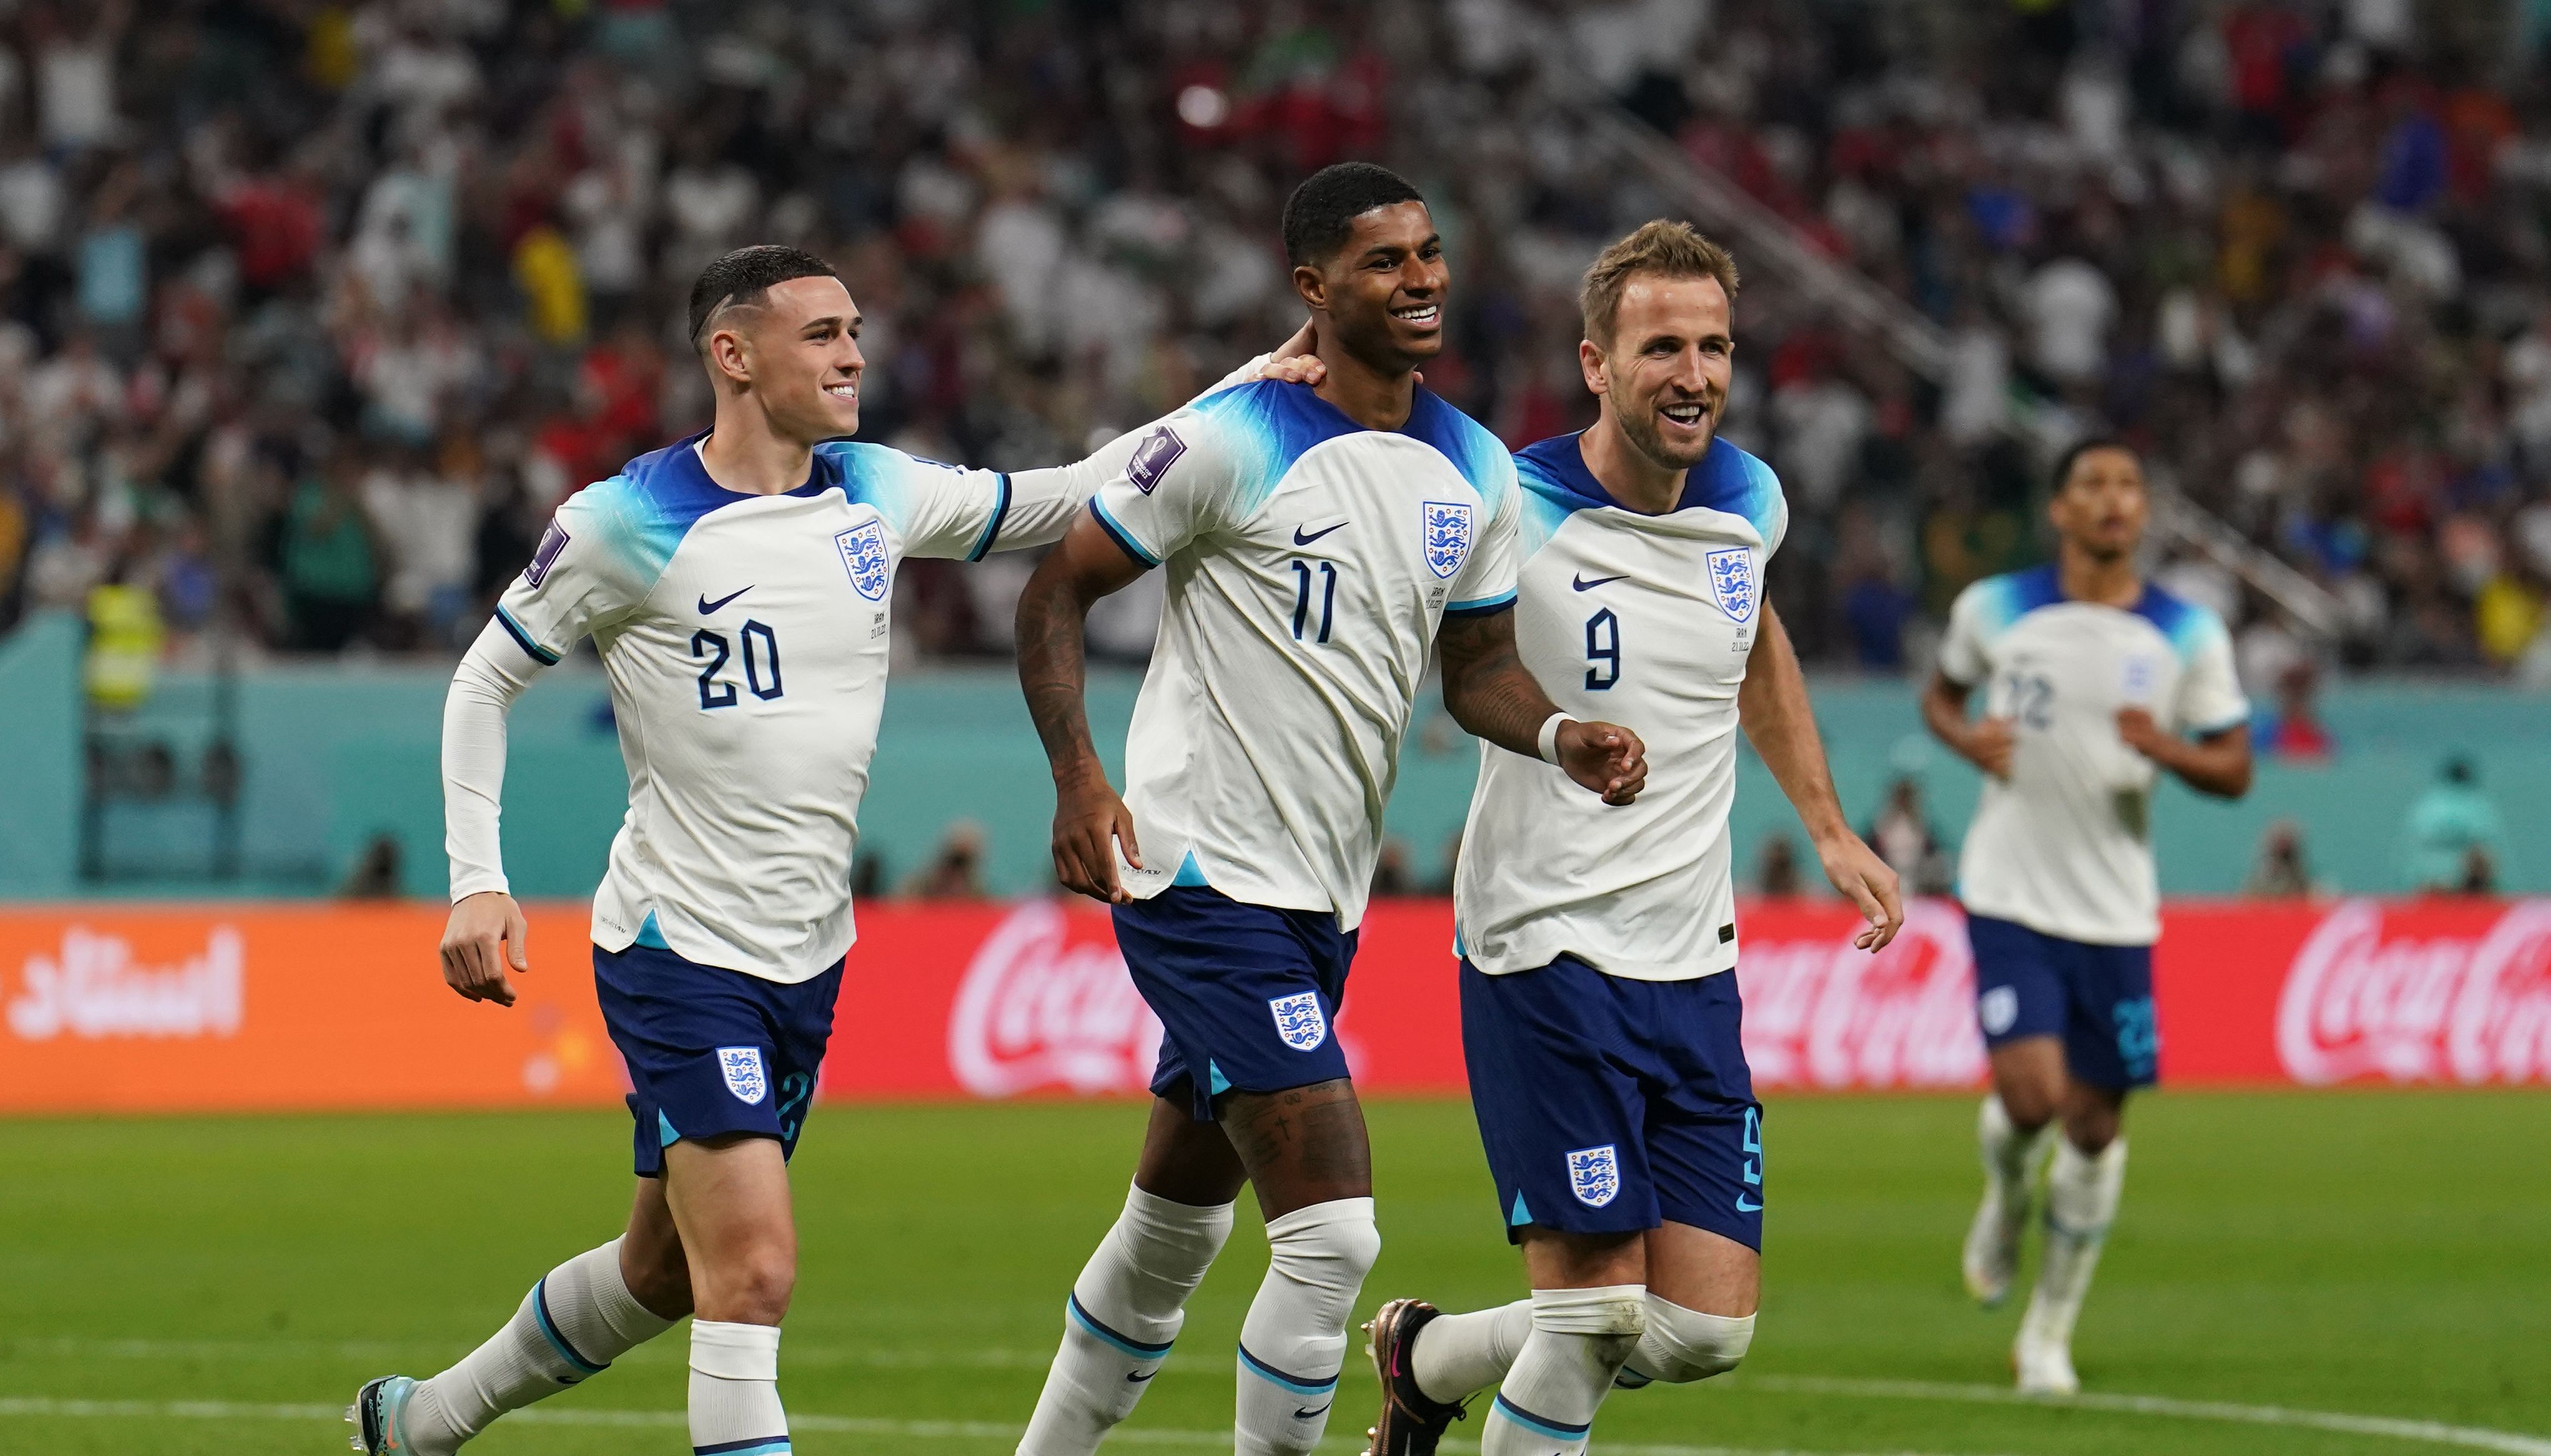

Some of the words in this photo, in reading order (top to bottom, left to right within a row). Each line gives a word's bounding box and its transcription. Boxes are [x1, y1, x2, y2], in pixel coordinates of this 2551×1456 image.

[1291, 560, 1337, 644] 11
[1736, 628, 1747, 638] IRAN
[691, 618, 784, 711] 20
[1584, 605, 1621, 692] 9
[775, 1070, 813, 1141] 2
[1743, 1106, 1762, 1185] 9
